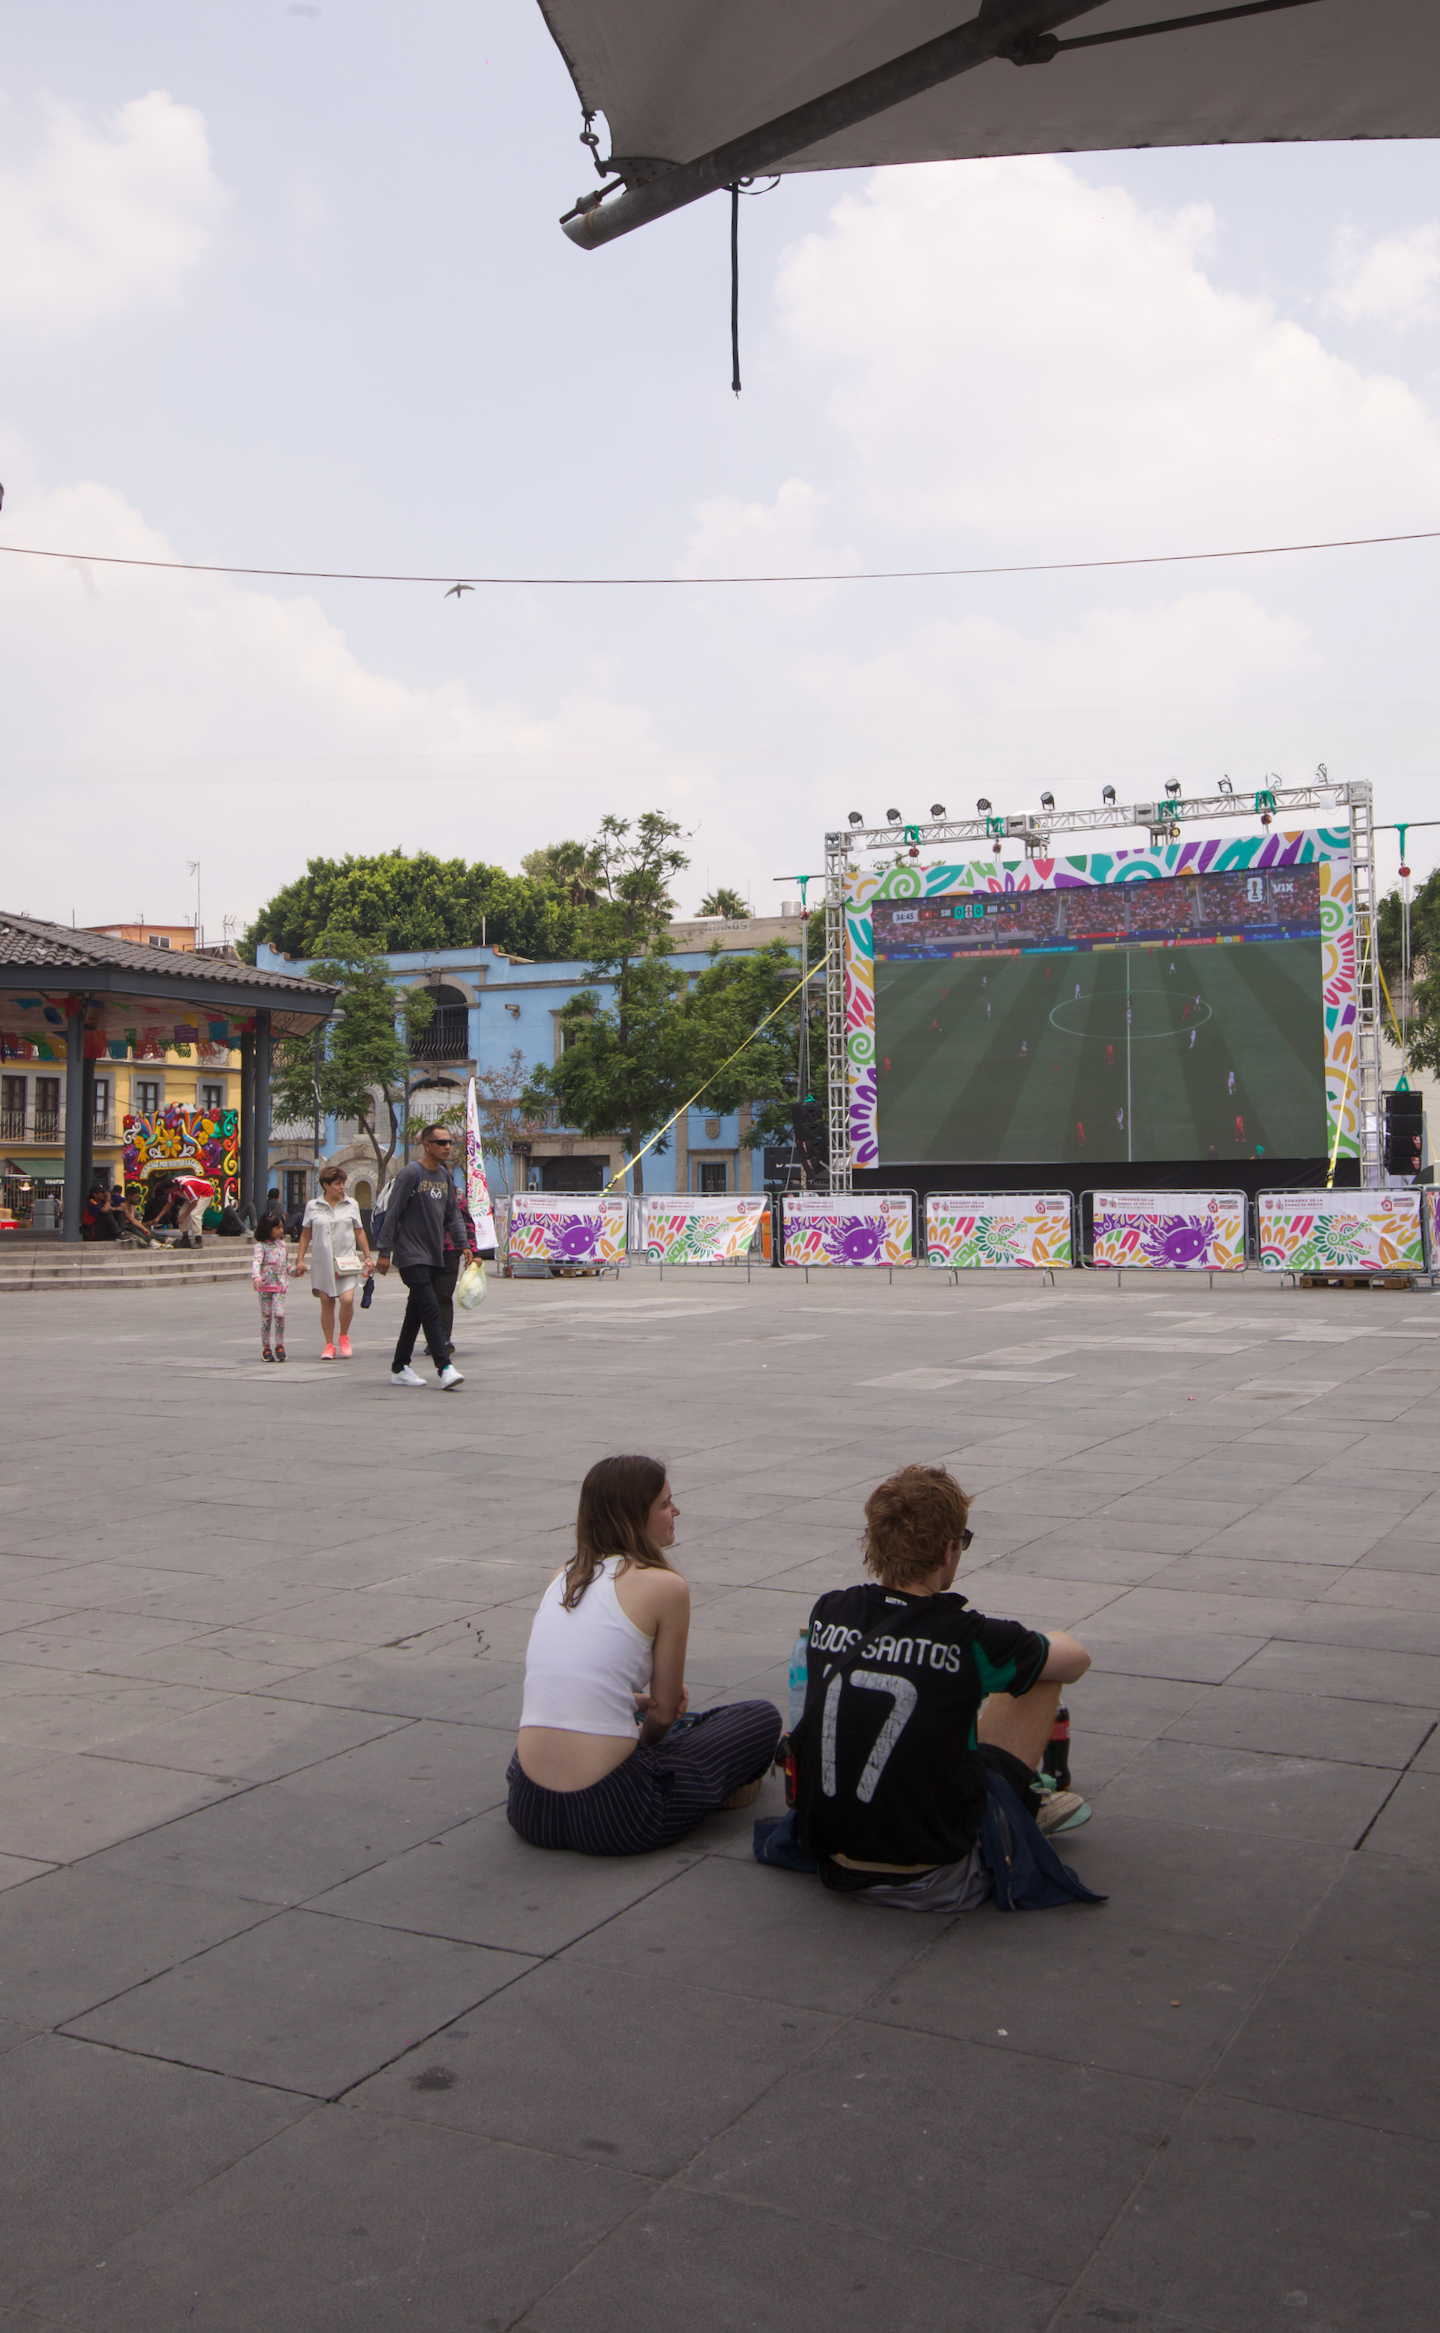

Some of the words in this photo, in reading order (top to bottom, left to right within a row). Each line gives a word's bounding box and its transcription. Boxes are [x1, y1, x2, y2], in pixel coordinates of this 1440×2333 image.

[895, 912, 914, 921] 34:45
[940, 909, 951, 917] SUI
[1175, 937, 1213, 946] ExpressVPN
[821, 1663, 918, 1804] 17
